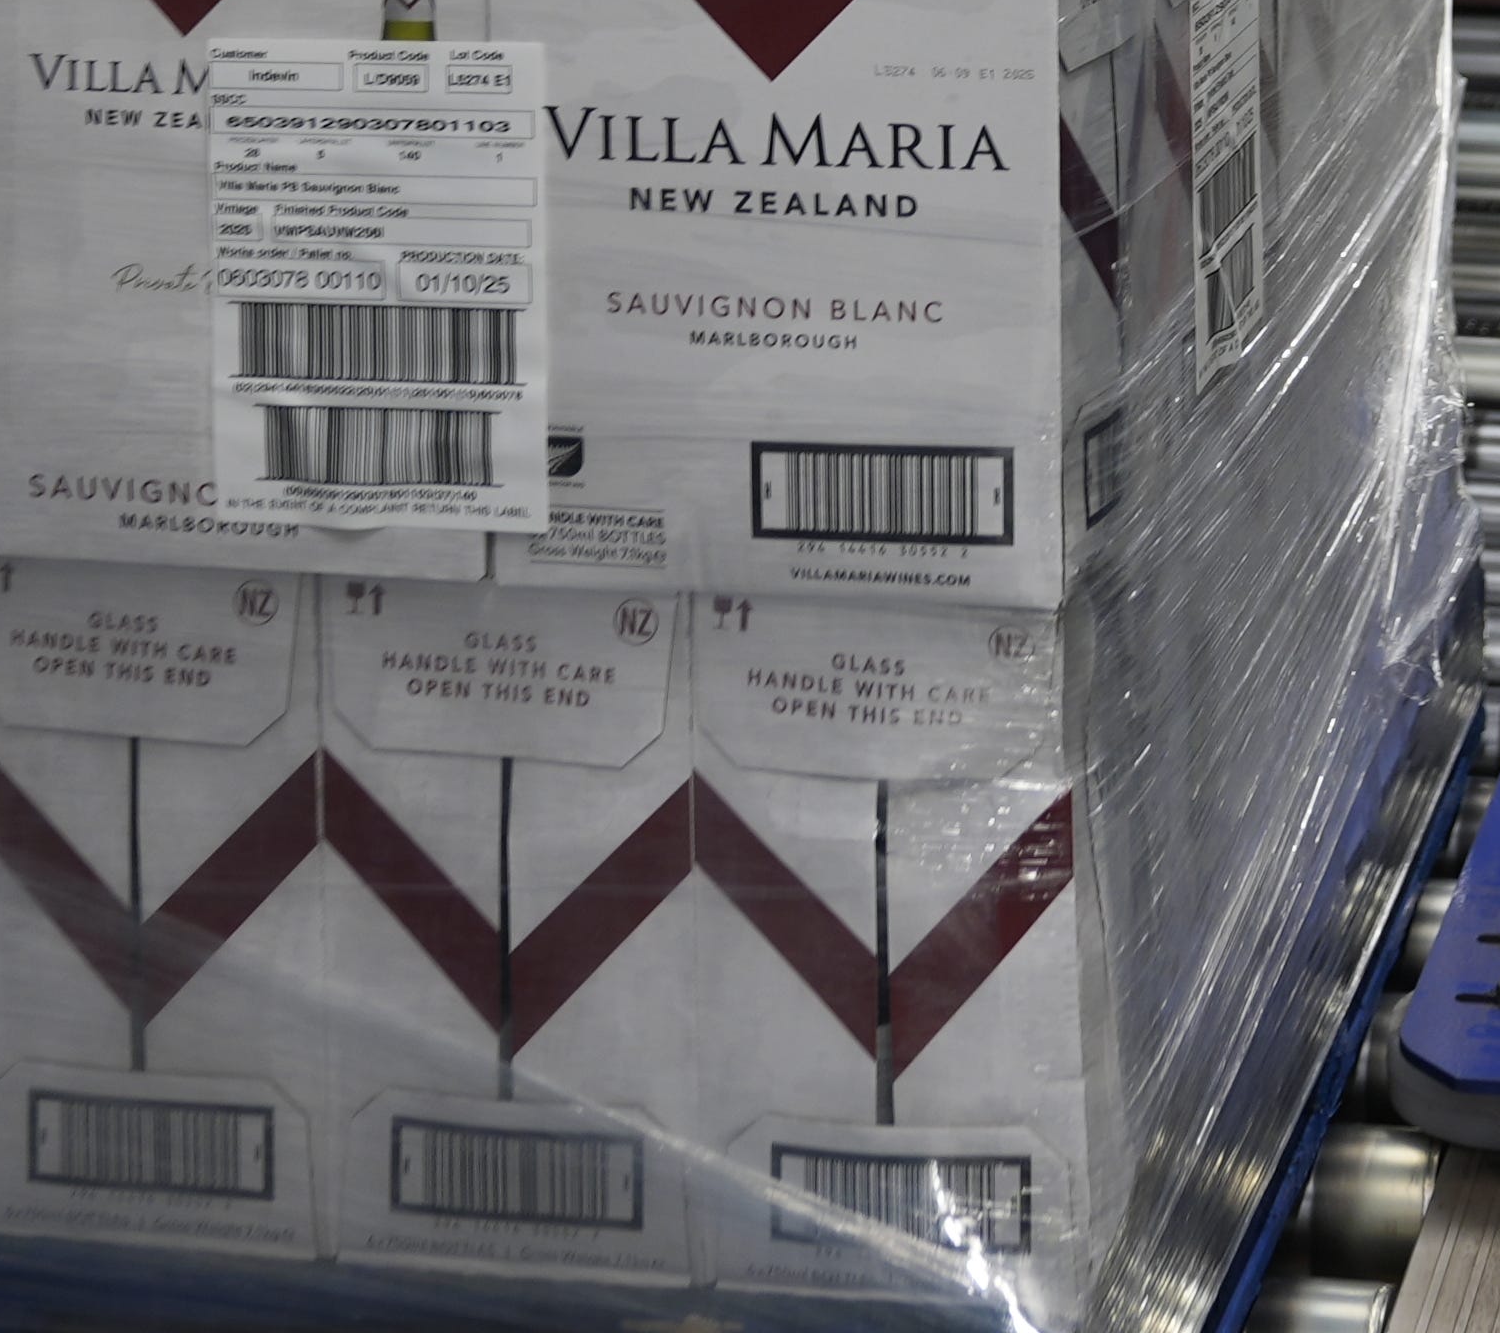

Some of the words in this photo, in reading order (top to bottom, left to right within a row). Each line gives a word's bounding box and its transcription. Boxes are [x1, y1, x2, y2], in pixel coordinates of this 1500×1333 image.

[398, 51, 428, 61] Code
[472, 50, 503, 60] Code
[29, 53, 163, 94] VILLA
[85, 109, 142, 125] NEW
[544, 106, 745, 164] VILLA
[761, 113, 1009, 170] MARIA
[630, 188, 713, 212] NEW
[735, 191, 917, 217] ZEALAND
[417, 273, 510, 293] 01/10/25
[608, 292, 810, 319] SAUVIGNON
[831, 299, 942, 323] BLANC
[690, 330, 856, 349] MARLBOROUGH
[119, 513, 299, 538] MARLBOROUGH
[791, 567, 970, 586] VILLAMARIAWINES.COM
